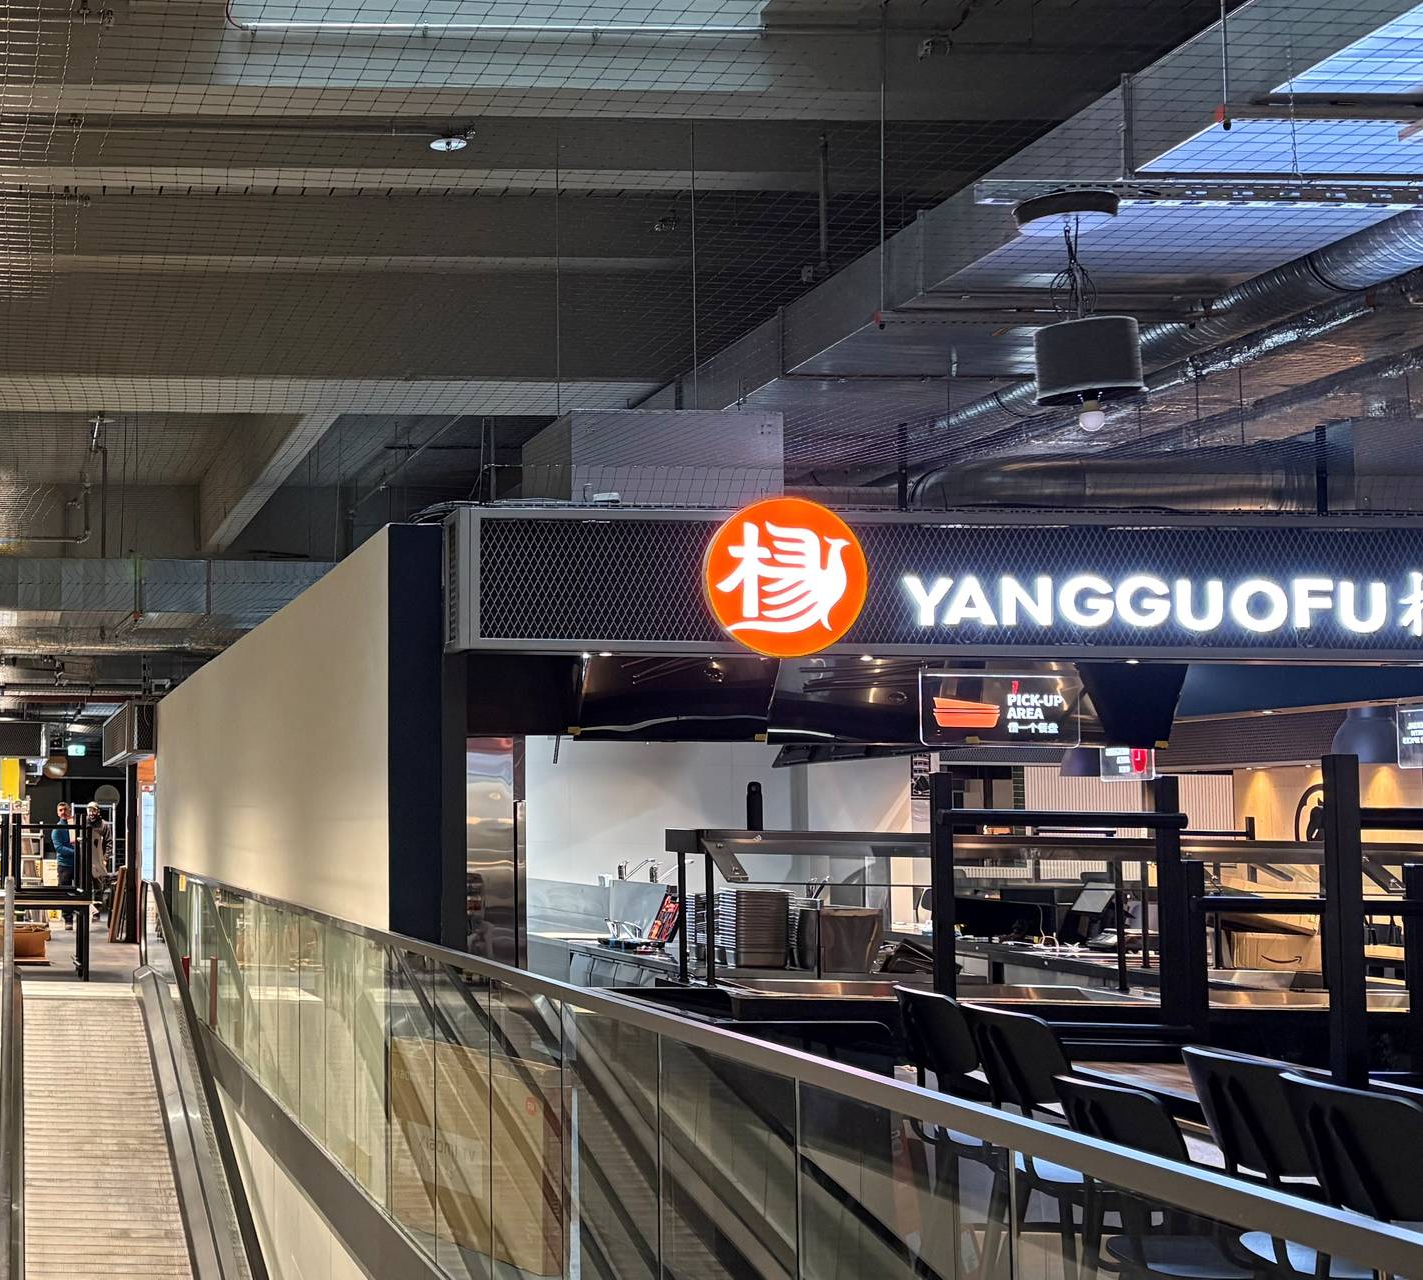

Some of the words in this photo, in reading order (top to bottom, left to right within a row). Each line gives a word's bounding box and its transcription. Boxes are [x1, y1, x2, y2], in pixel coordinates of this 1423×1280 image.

[902, 575, 1387, 635] YANGGUOFU
[1007, 694, 1063, 707] PICK-UP
[1007, 707, 1044, 720] AREA
